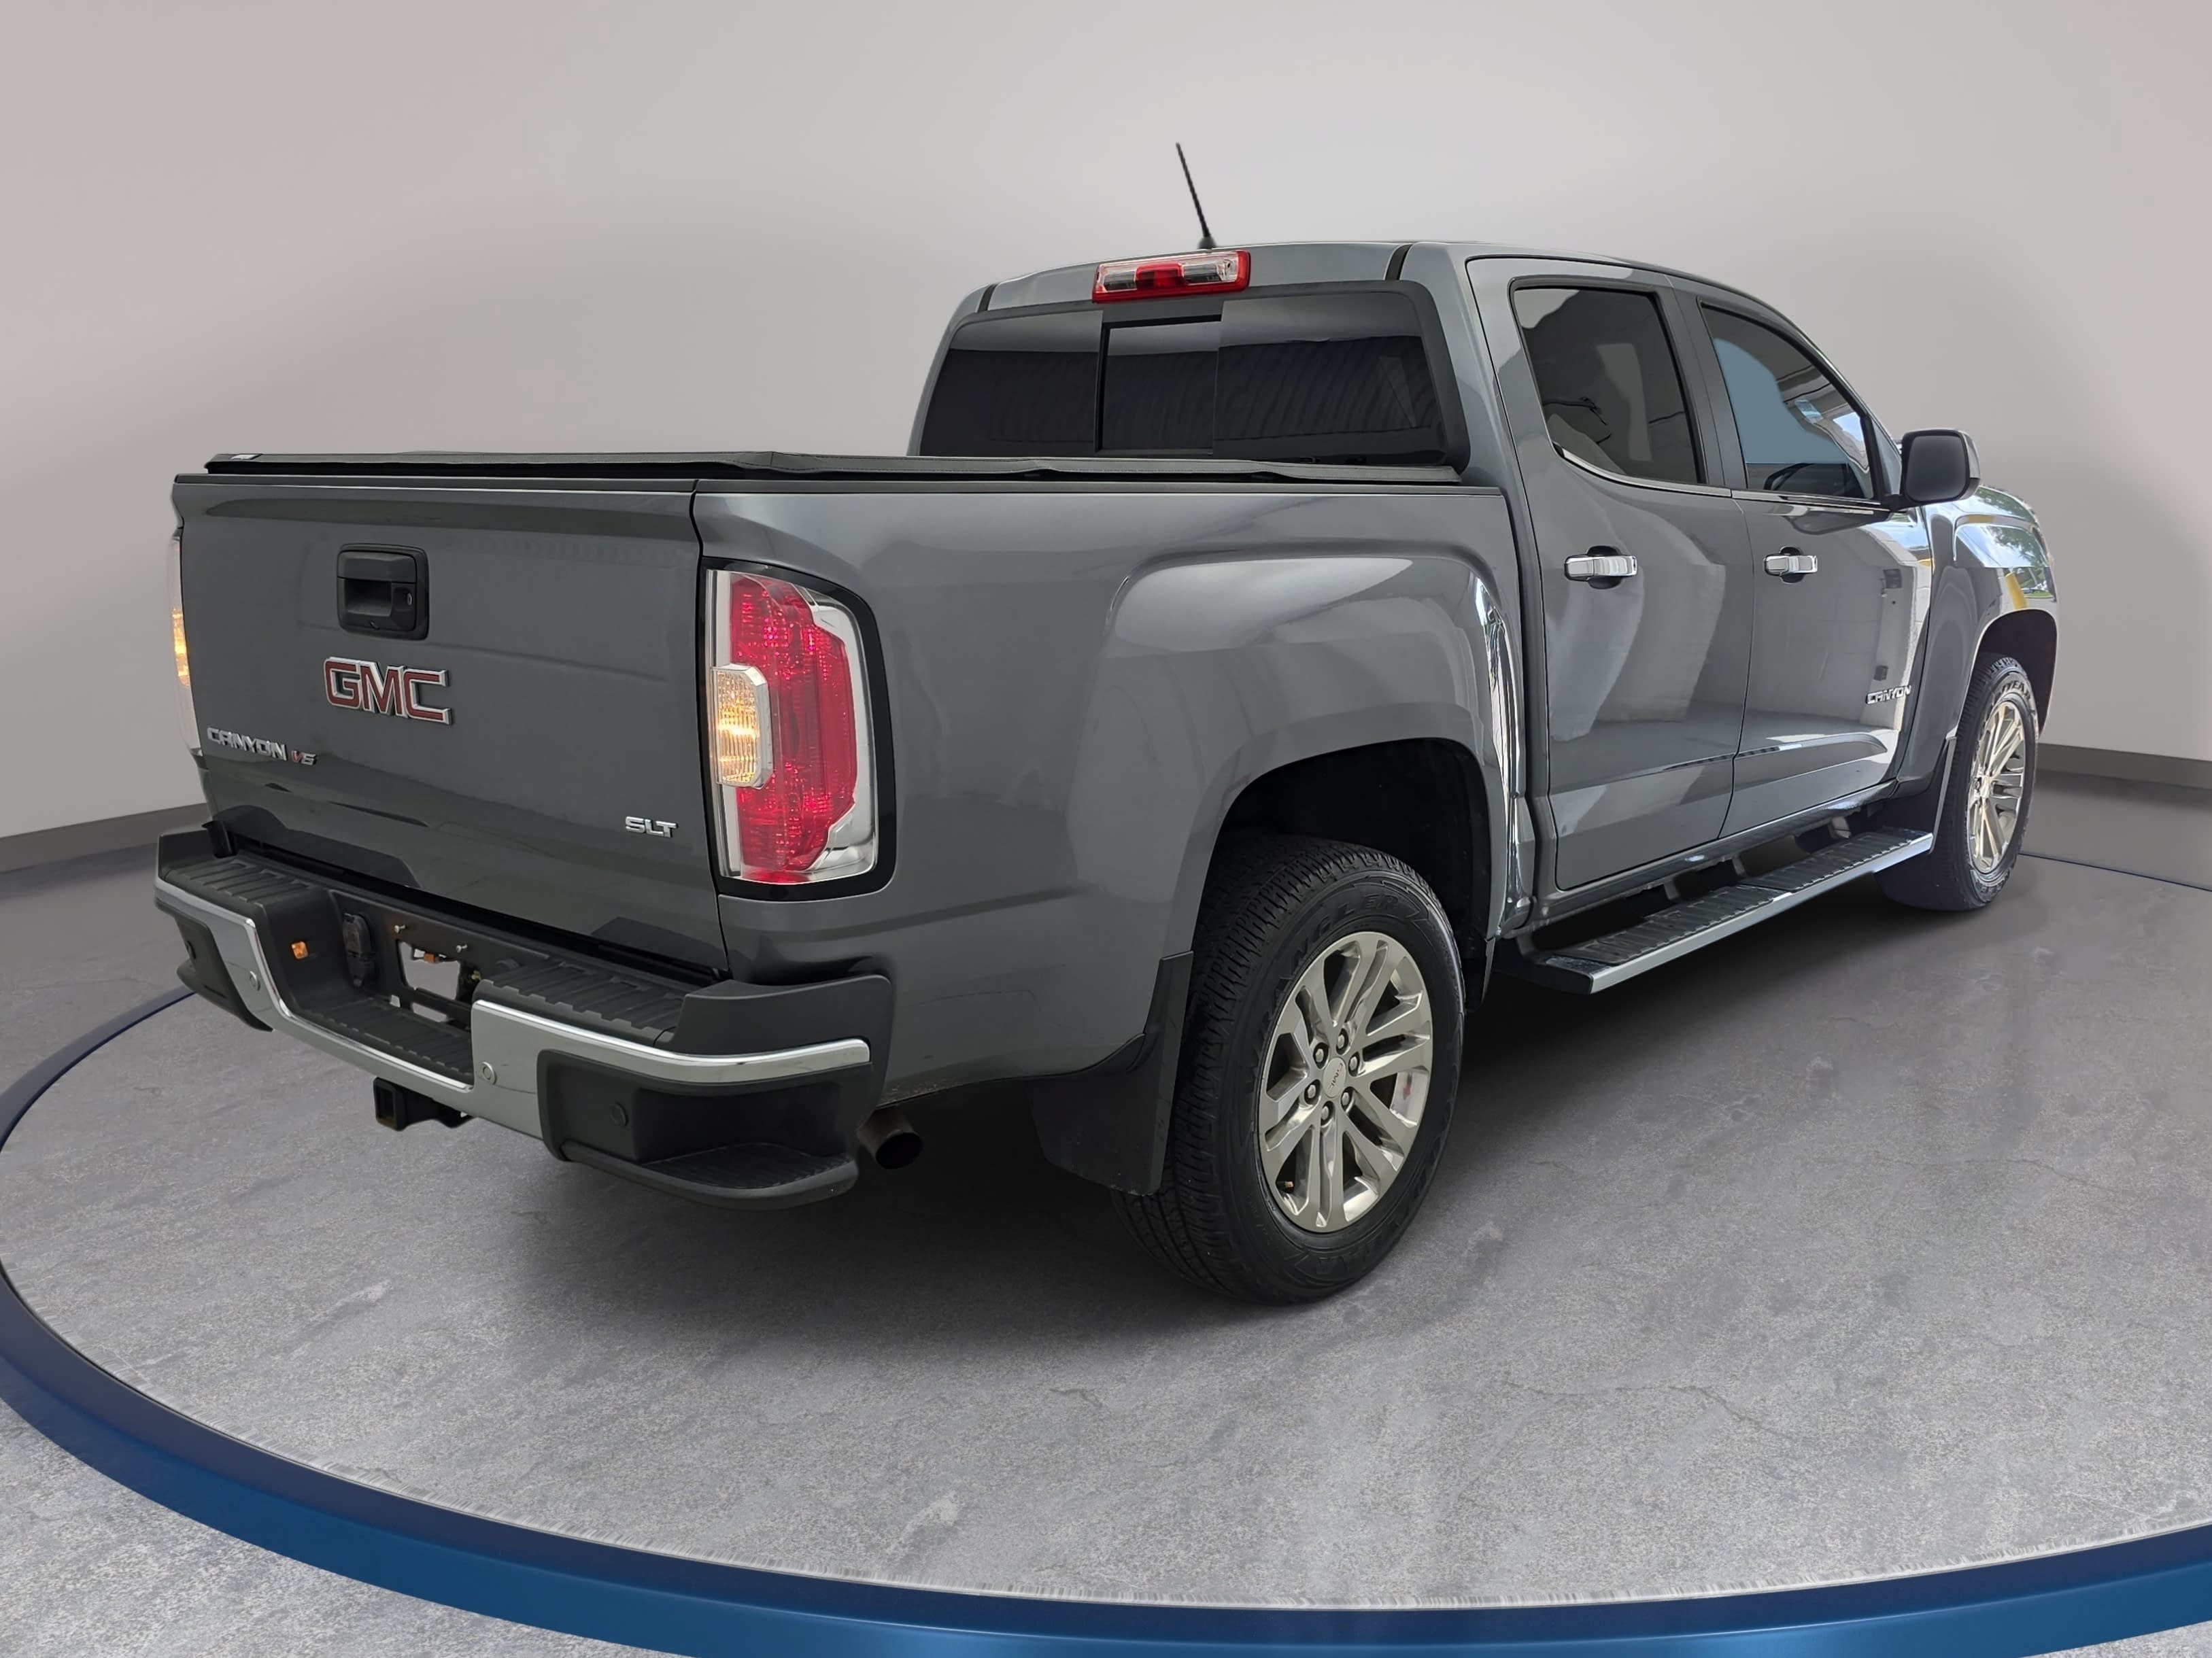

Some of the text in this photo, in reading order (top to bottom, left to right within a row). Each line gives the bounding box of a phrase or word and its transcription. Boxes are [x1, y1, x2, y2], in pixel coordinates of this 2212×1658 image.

[324, 657, 452, 725] GMC
[1866, 685, 1911, 704] CANYON
[207, 727, 316, 765] CANYON V6
[626, 816, 677, 837] SLT
